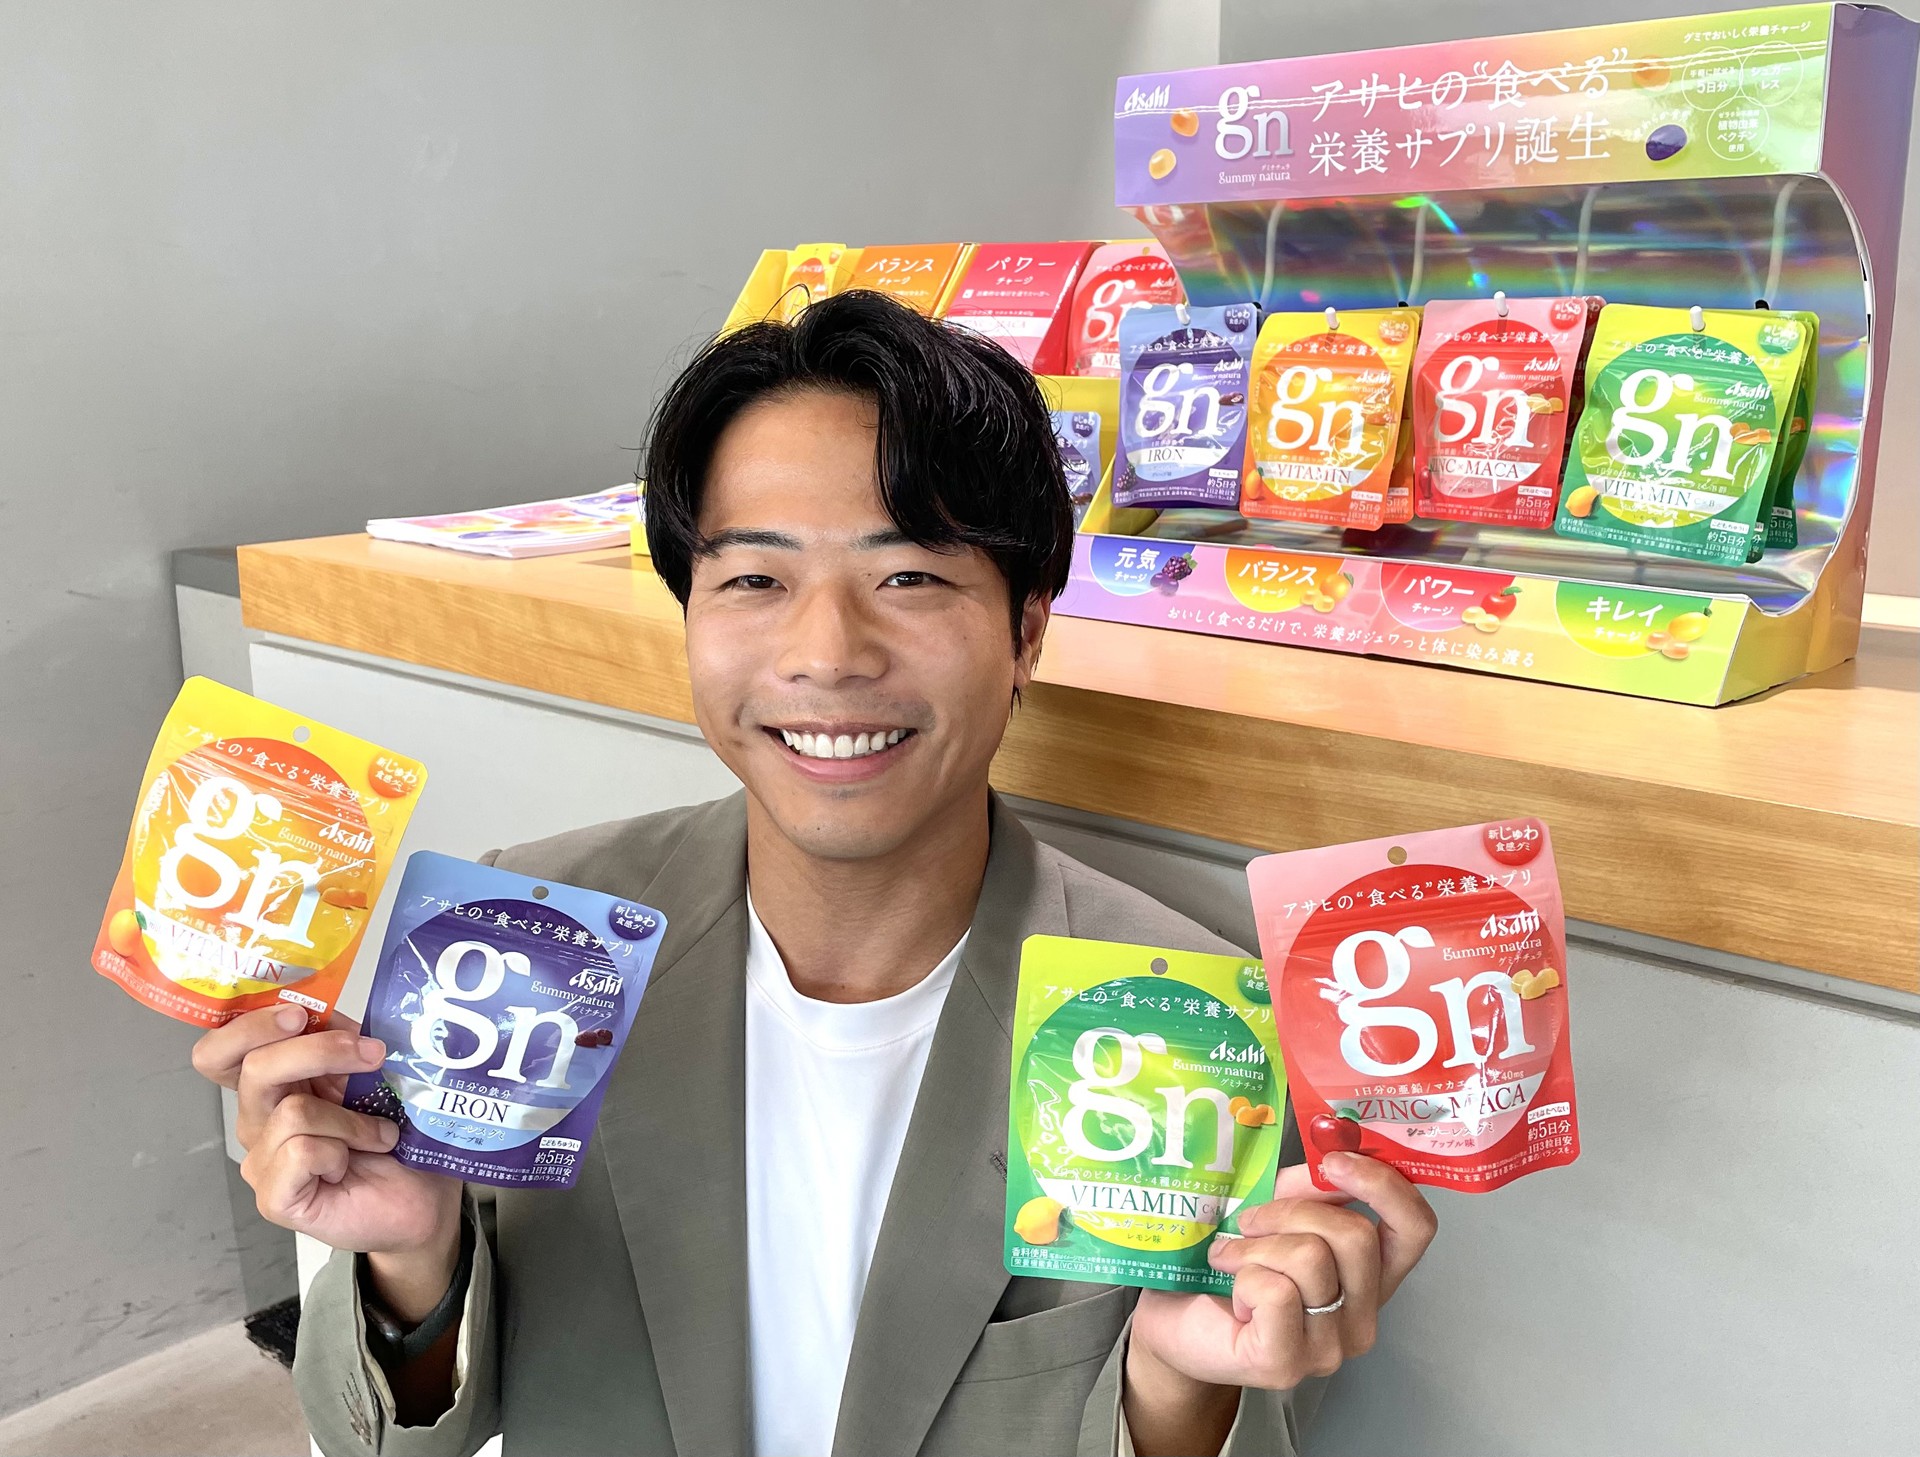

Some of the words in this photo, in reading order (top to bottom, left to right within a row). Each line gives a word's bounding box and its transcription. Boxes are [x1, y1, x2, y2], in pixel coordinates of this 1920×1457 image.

[1683, 21, 1811, 44] グミでおいしく栄養チャージ
[1751, 66, 1792, 77] シュガー
[1311, 47, 1628, 122] アサヒの“食べる”
[1697, 81, 1728, 94] 5日分
[1761, 79, 1780, 90] レス
[1124, 84, 1171, 112] Asahi
[1214, 85, 1293, 160] gn
[1718, 119, 1758, 131] 植物由来
[1308, 111, 1611, 177] 栄養サプリ誕生
[1717, 131, 1757, 143] ペクチン
[1729, 144, 1744, 153] 使用
[1218, 171, 1256, 186] gummy
[1259, 169, 1290, 182] natura
[865, 258, 934, 273] バランス
[986, 257, 1056, 273] パワー
[877, 276, 911, 285] チャージ
[996, 276, 1034, 285] チャージ
[1435, 330, 1569, 343] アサヒの“食べる”栄養サプリ
[1214, 357, 1244, 372] Asahi
[1523, 357, 1561, 371] Asahi
[1356, 369, 1391, 385] Asahi
[1135, 362, 1224, 438] gn
[1725, 381, 1772, 400] Asahi
[1267, 365, 1368, 455] gn
[1434, 355, 1534, 447] gn
[1694, 393, 1732, 408] gummy
[1605, 368, 1734, 480] gn
[1148, 447, 1185, 462] IRON
[1277, 463, 1351, 484] VITAMIN
[1465, 460, 1519, 478] MACA
[1516, 496, 1551, 509] 約5日分
[1604, 479, 1691, 507] VITAMIN
[1707, 531, 1746, 546] 約5日分
[1114, 547, 1159, 570] 元気
[1705, 543, 1744, 555] 1日3粒目安
[1114, 570, 1147, 582] チャージ
[1238, 561, 1317, 586] バランス
[1251, 585, 1288, 598] チャージ
[1403, 575, 1474, 599] パワー
[1411, 602, 1454, 616] チャージ
[1586, 596, 1664, 627] キレイ
[1167, 606, 1534, 668] おいしく食べるだけで、栄養がジュワっと体に染み渡る
[1594, 627, 1642, 642] チャージ
[184, 725, 390, 816] アサヒの“食べる”栄養サプリ
[375, 756, 417, 784] 新じゅわ
[318, 822, 375, 854] Asahi
[1488, 825, 1538, 841] 新じゅわ
[278, 826, 325, 856] gummy
[325, 848, 365, 868] natura
[1495, 841, 1531, 852] 食感グミ
[159, 776, 321, 949] gn
[1283, 869, 1532, 919] アサヒの“食べる”栄養サプリ
[420, 895, 634, 957] アサヒの“食べる”栄養サプリ
[615, 905, 656, 928] 新じゅわ
[616, 917, 645, 934] 食感グミ
[1480, 908, 1540, 939] Asahi
[170, 924, 287, 982] VITAMIN
[1443, 946, 1497, 961] gummy
[1499, 938, 1542, 952] natura
[1498, 951, 1542, 967] グミナチュラ
[569, 969, 624, 997] Asahi
[280, 991, 325, 1010] こどもちゅうい
[530, 981, 578, 1002] gummy
[578, 994, 615, 1010] natura
[1043, 985, 1270, 1024] アサヒの“食べる”栄養サプリ
[1340, 925, 1535, 1077] gn
[410, 940, 579, 1091] gn
[571, 1005, 612, 1019] グミナチュラ
[1209, 1041, 1265, 1065] Asahi
[1172, 1058, 1222, 1076] gummy
[1224, 1066, 1264, 1081] natura
[1220, 1078, 1263, 1092] グミナチュラ
[1354, 1083, 1423, 1096] 1日分の亜鉛
[438, 1091, 511, 1123] IRON
[1063, 1027, 1236, 1174] gn
[1357, 1100, 1431, 1120] ZINC
[1528, 1105, 1569, 1121] こどもはたべない
[444, 1131, 484, 1146] グレープ味
[1528, 1120, 1571, 1142] 約5日分
[541, 1139, 579, 1149] こどもちゅうい
[1430, 1139, 1475, 1148] アップル味
[1529, 1136, 1572, 1154] 1日3粒目安
[534, 1150, 575, 1166] 約5日分
[531, 1166, 572, 1177] 1日2粒目安
[1055, 1167, 1230, 1195] 日分のビタミンC・4種のビタミンB群
[1072, 1184, 1200, 1219] VITAMIN
[1127, 1233, 1162, 1244] レモン味
[1012, 1247, 1048, 1258] 香料使用
